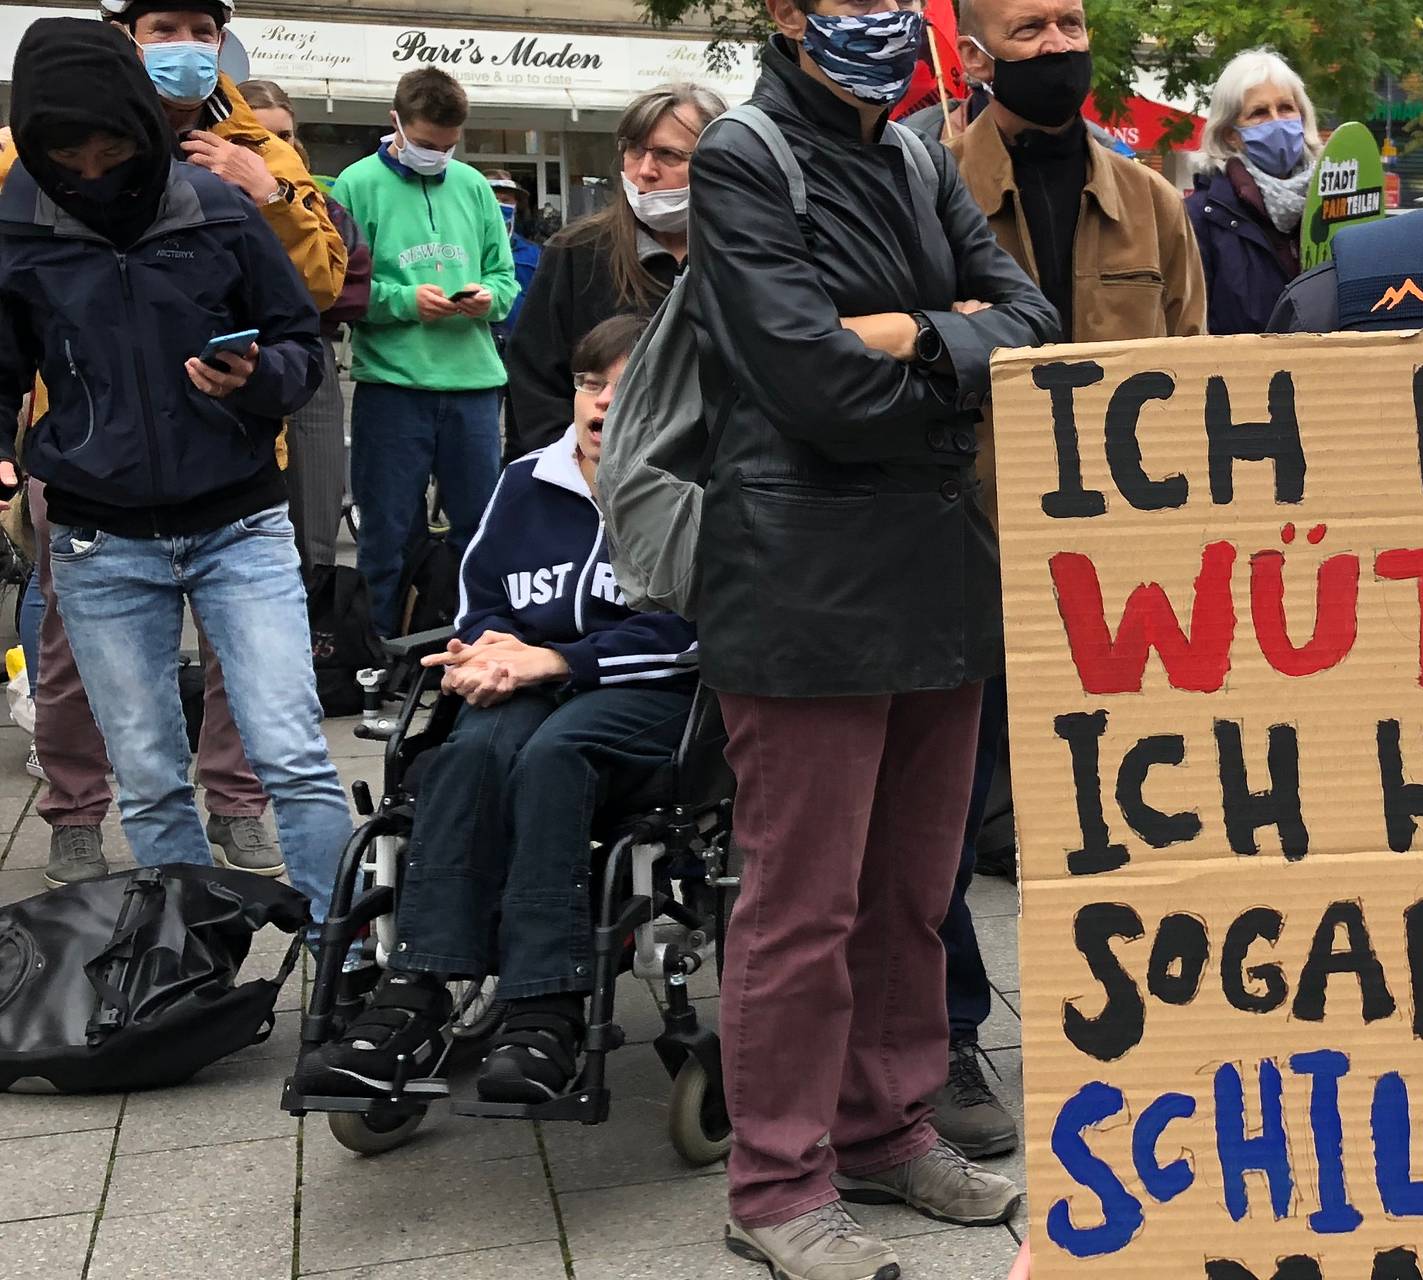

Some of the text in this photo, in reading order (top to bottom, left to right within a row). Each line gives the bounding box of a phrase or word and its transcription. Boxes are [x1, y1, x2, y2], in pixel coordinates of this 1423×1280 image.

[246, 46, 295, 62] lusive
[300, 50, 352, 68] design
[491, 36, 604, 70] Moden
[451, 69, 572, 86] lusive & up to date
[1320, 169, 1355, 193] STADT
[1031, 361, 1307, 518] ICH
[501, 561, 573, 610] UST
[1054, 709, 1310, 875] ICH
